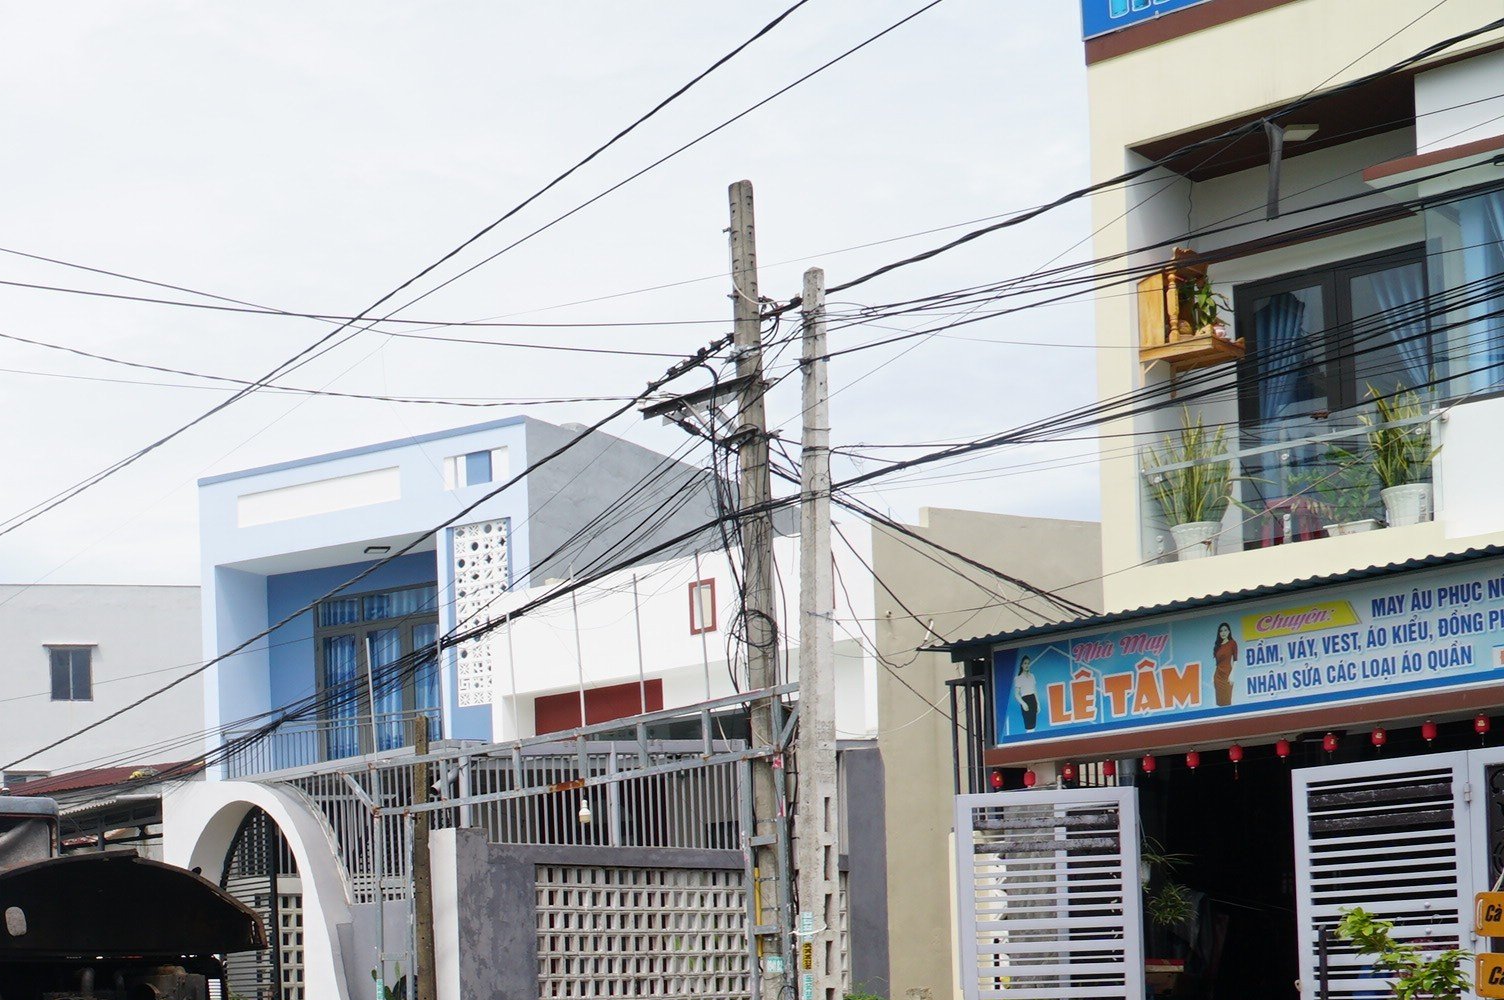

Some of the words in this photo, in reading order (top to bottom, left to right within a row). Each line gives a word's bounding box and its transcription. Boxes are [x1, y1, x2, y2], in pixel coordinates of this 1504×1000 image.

[1371, 594, 1405, 617] MAY
[1410, 588, 1432, 611] ÂU
[1437, 582, 1482, 608] PHỤC
[1072, 640, 1114, 663] Nhà
[1119, 633, 1169, 656] May
[1246, 640, 1284, 666] ĐẦM,
[1288, 636, 1317, 660] VÁY,
[1322, 632, 1361, 654] VEST,
[1366, 625, 1387, 648] ÁO
[1392, 615, 1433, 644] KIỂU,
[1438, 609, 1484, 637] ĐỒNG
[1047, 667, 1097, 726] LÊ
[1102, 657, 1202, 717] TÂM
[1247, 670, 1287, 695] NHẬN
[1292, 663, 1322, 689] SỬA
[1326, 660, 1357, 683] CÁC
[1362, 657, 1396, 680] LOẠI
[1401, 650, 1422, 673] ÁO
[1427, 640, 1472, 671] QUẦN
